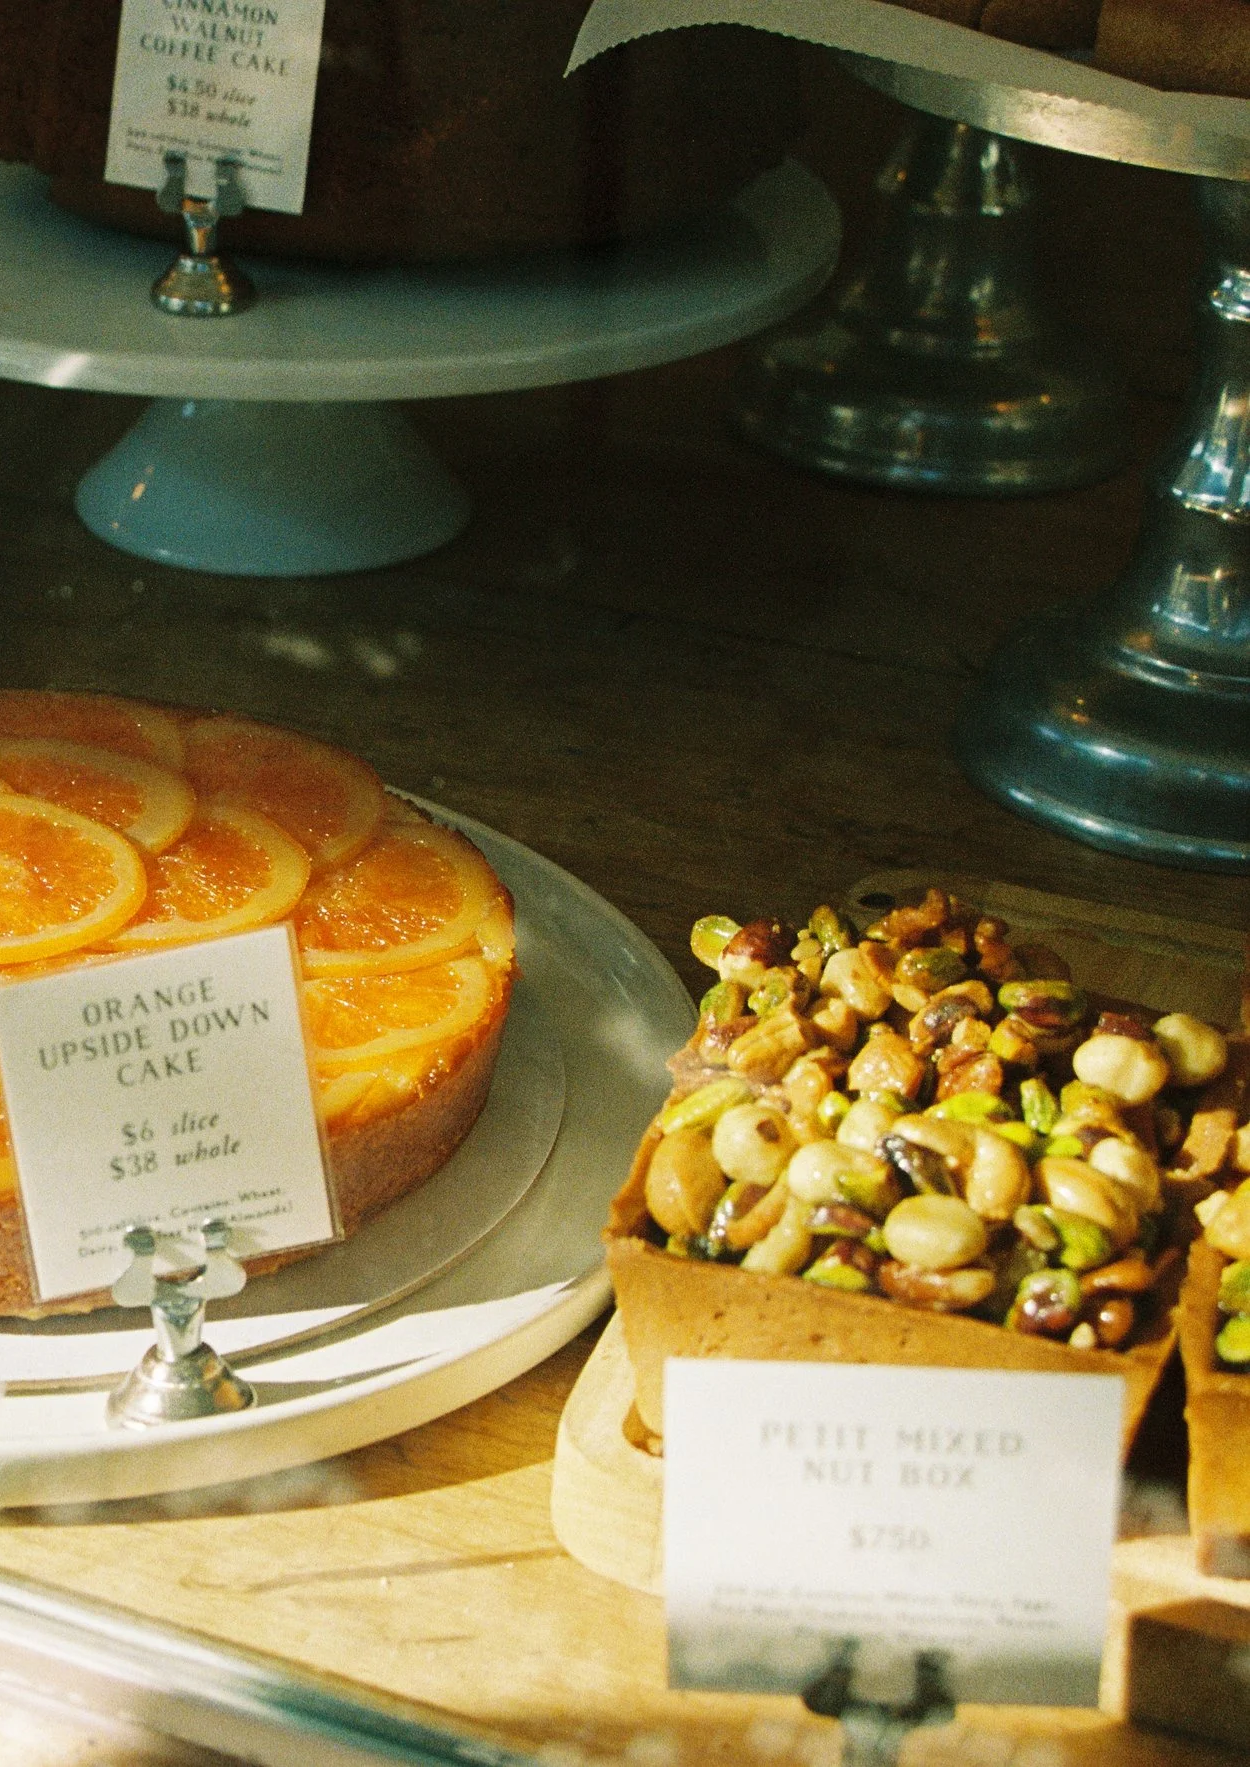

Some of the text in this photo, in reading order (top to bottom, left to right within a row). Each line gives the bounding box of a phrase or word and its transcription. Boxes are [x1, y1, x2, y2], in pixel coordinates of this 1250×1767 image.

[171, 16, 263, 47] WALNUT
[140, 35, 289, 76] COFFEE CAKE
[206, 109, 251, 127] whole
[82, 976, 217, 1028] ORANGE
[38, 1001, 272, 1072] UPSIDE DOWN
[117, 1049, 204, 1087] CAKE
[121, 1111, 220, 1147] $6 slice
[110, 1133, 241, 1182] $38 whole
[760, 1420, 1027, 1459] PETIT MIXED
[802, 1457, 979, 1491] NUT BOX
